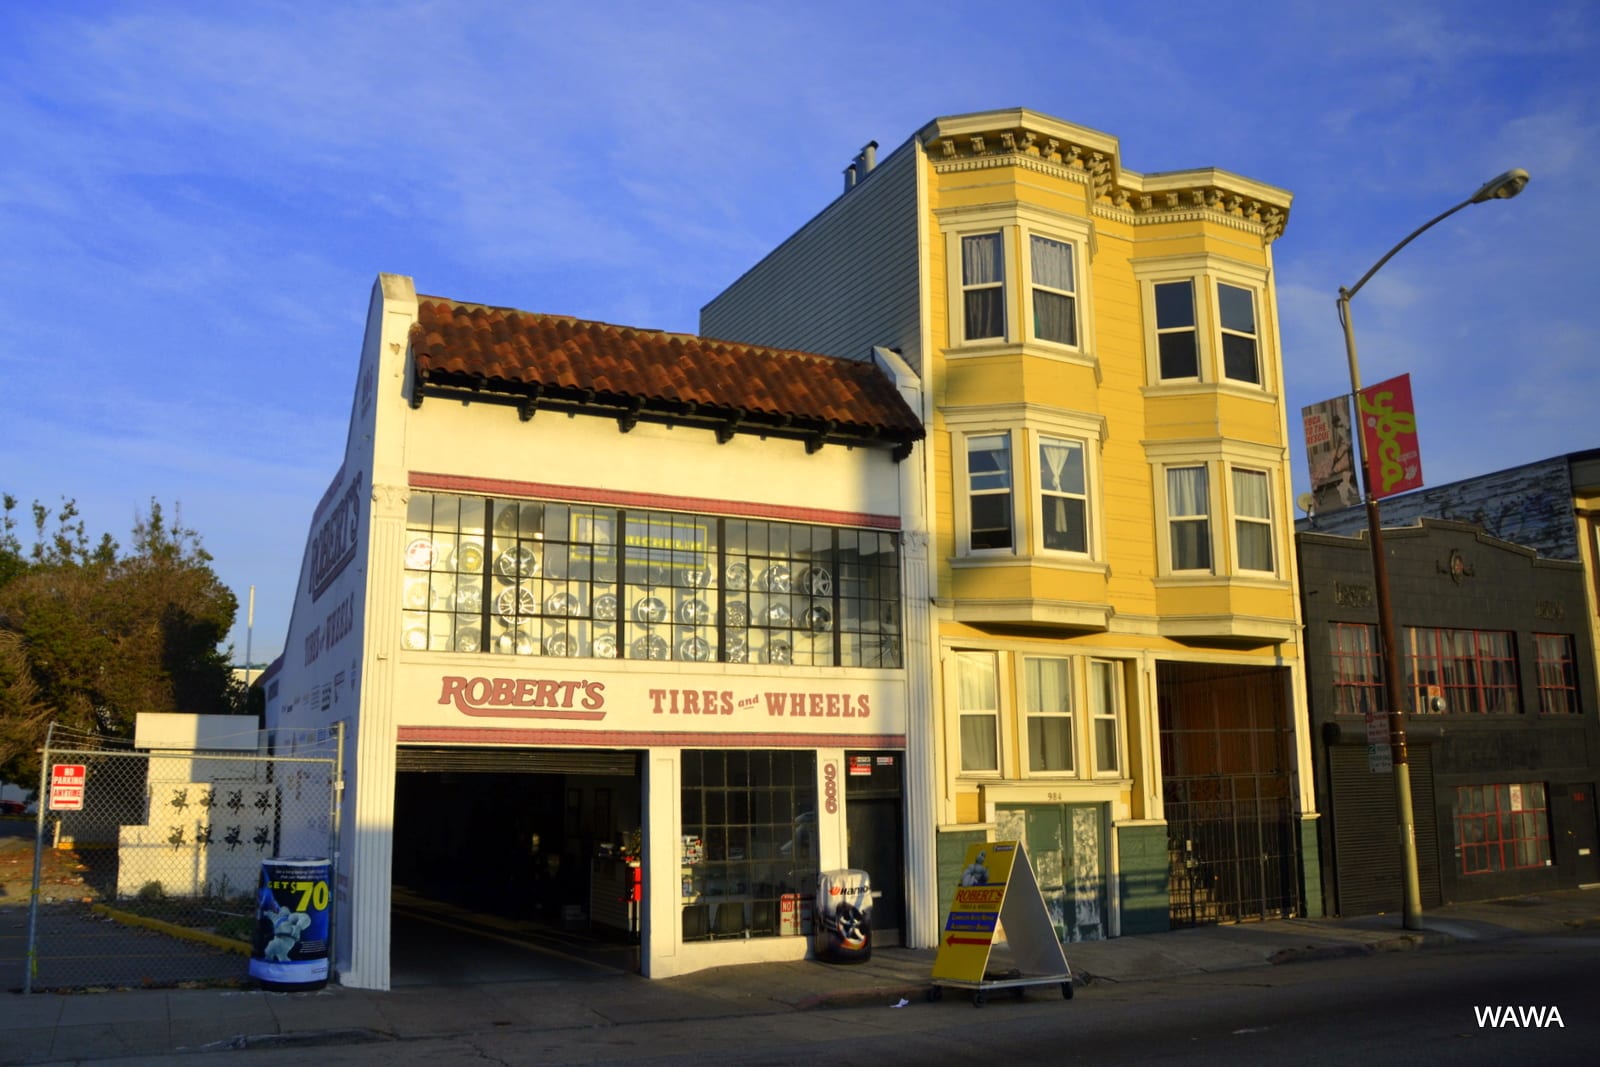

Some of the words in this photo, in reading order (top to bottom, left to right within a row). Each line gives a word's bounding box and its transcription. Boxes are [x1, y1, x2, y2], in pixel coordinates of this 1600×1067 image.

[438, 676, 606, 720] ROBERT'S
[649, 689, 735, 715] TIRES
[738, 694, 760, 710] and
[764, 691, 870, 718] WHEELS
[64, 767, 75, 776] NO
[53, 775, 83, 785] PARKING
[53, 788, 81, 797] ANYTIME
[267, 881, 289, 889] GET
